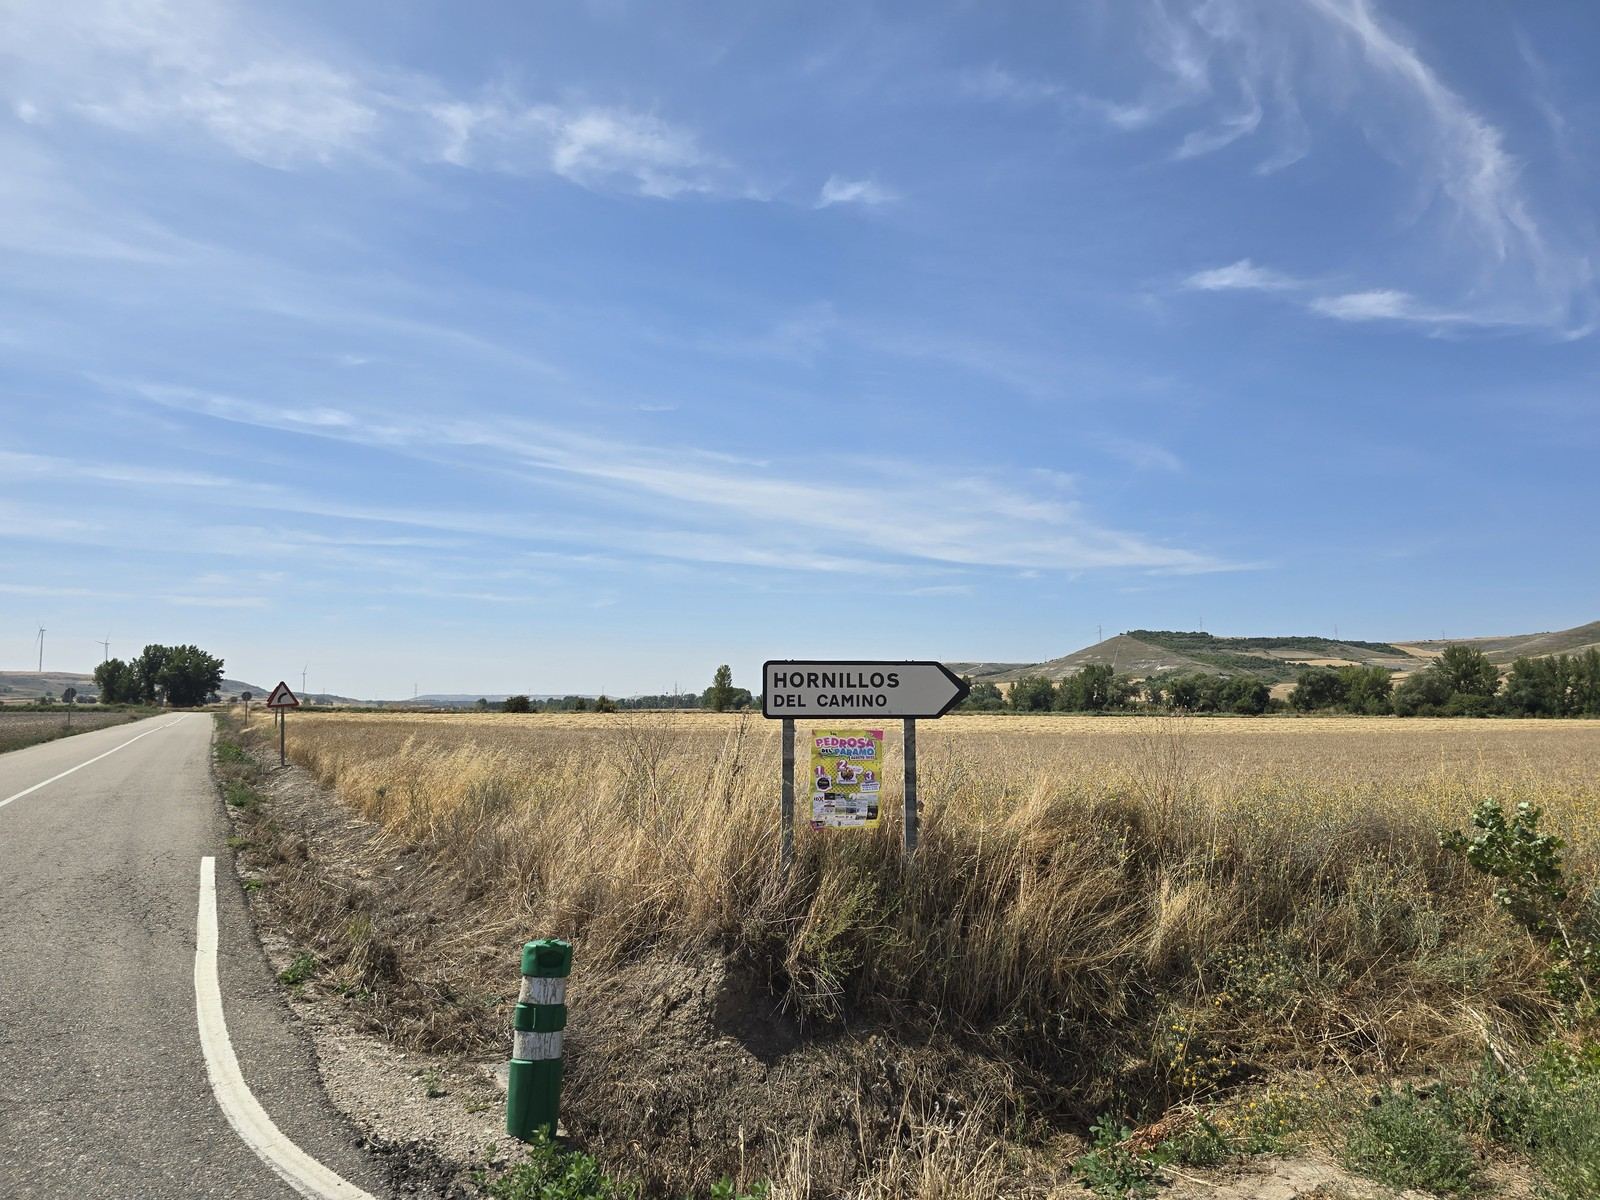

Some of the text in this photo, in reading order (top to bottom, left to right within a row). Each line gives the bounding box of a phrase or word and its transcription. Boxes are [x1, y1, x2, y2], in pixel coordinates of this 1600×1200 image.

[774, 672, 899, 688] HORNILLOS
[774, 694, 887, 707] DEL CAMINO
[815, 737, 875, 748] PEDROSA
[839, 760, 846, 770] 2
[866, 771, 873, 781] 3
